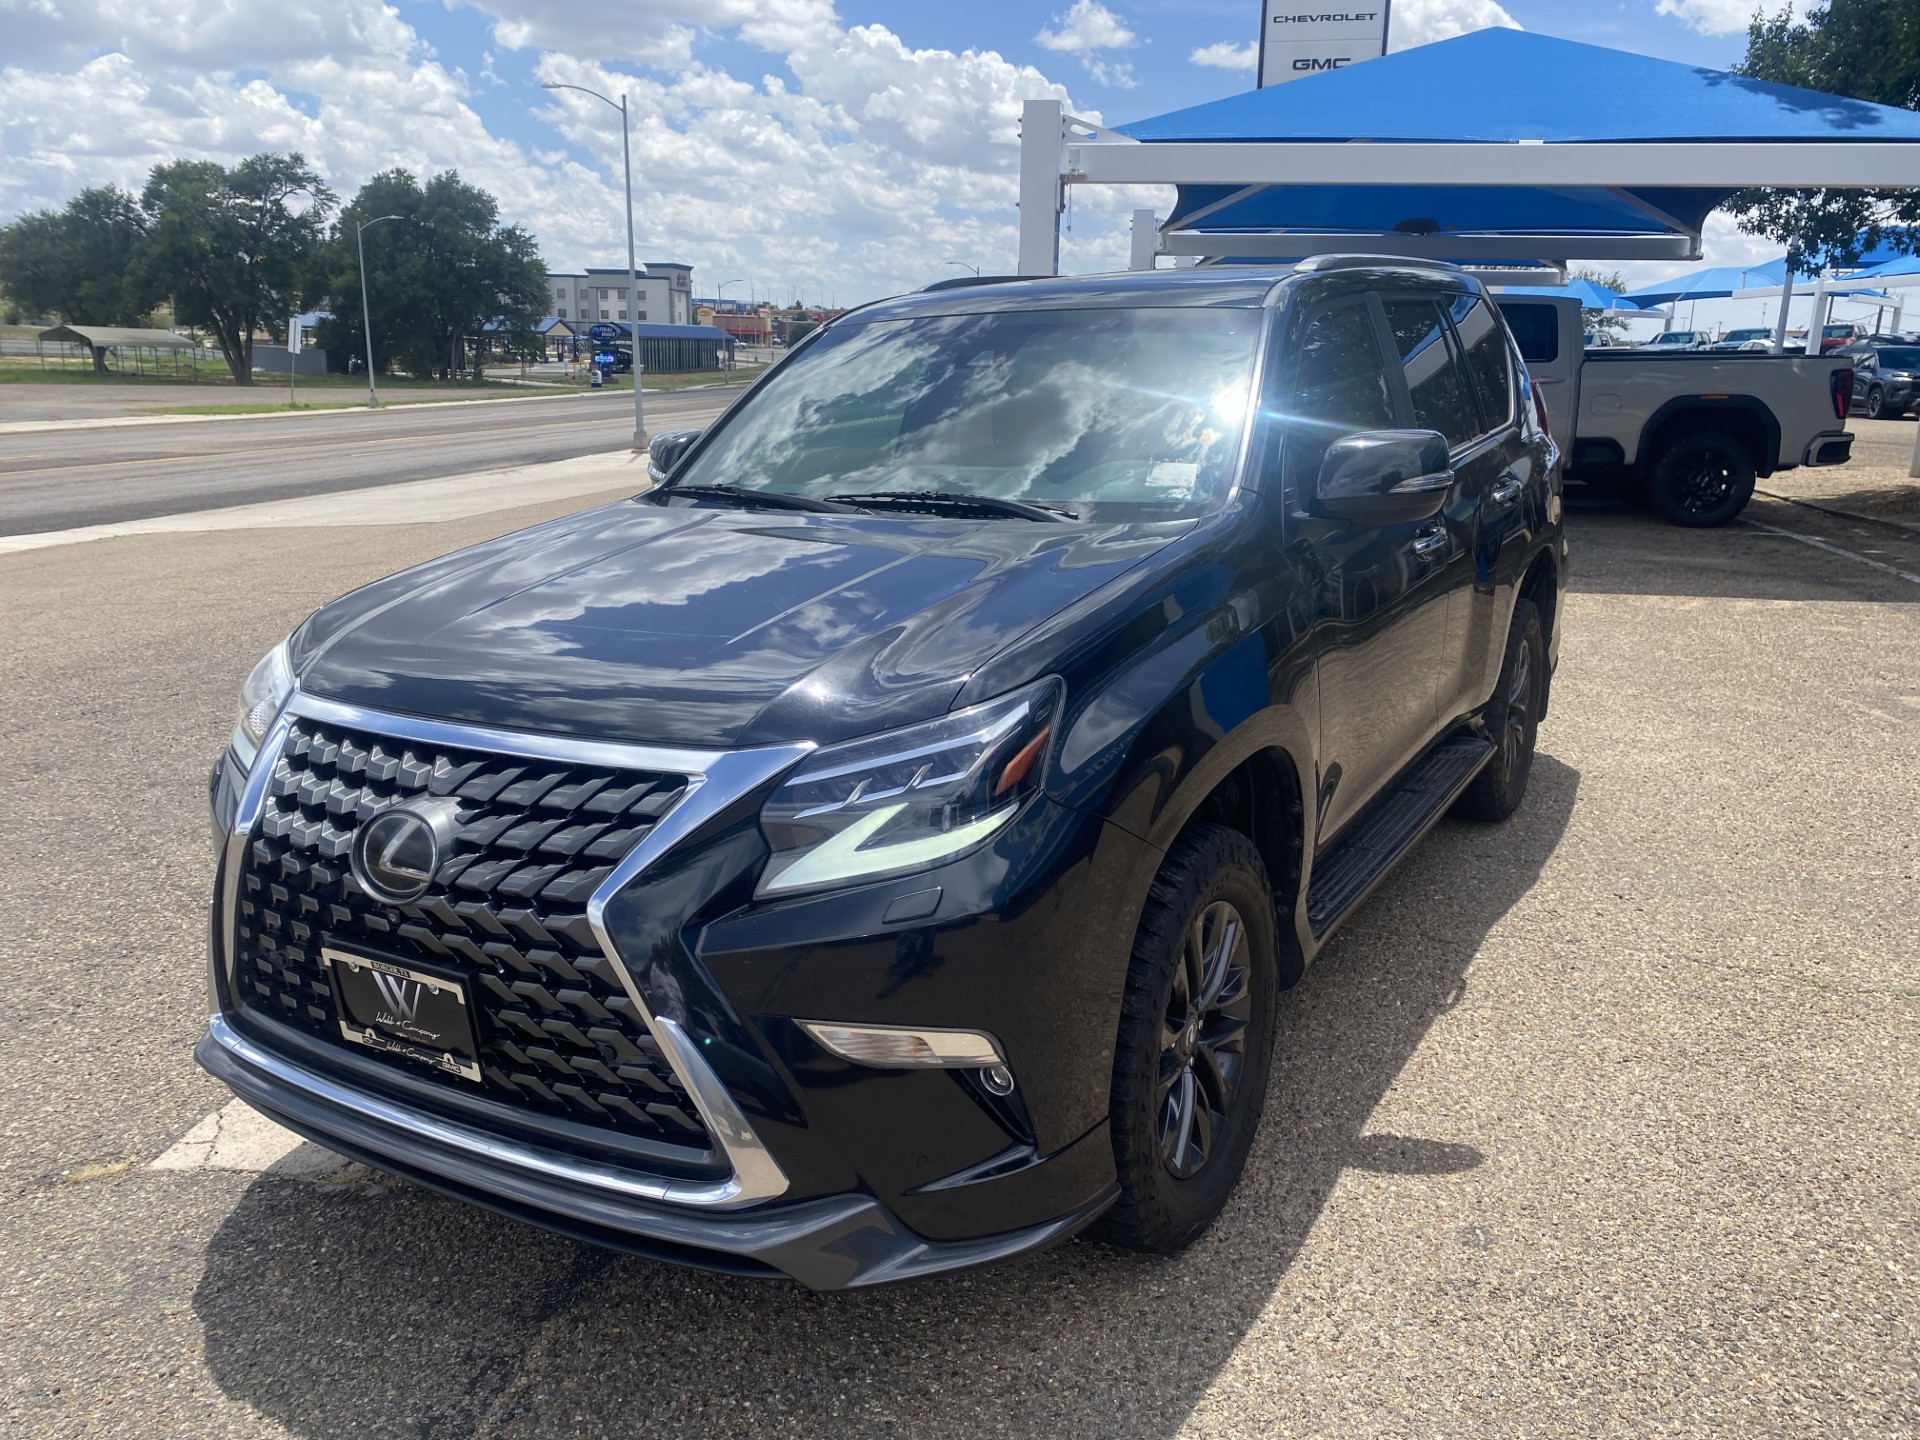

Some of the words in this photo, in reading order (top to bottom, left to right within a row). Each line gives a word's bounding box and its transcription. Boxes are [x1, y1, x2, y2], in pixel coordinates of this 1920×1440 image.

[1273, 13, 1377, 23] CHEVROLET
[1292, 58, 1351, 70] GMC
[402, 1020, 440, 1040] Company
[406, 1048, 436, 1065] Company
